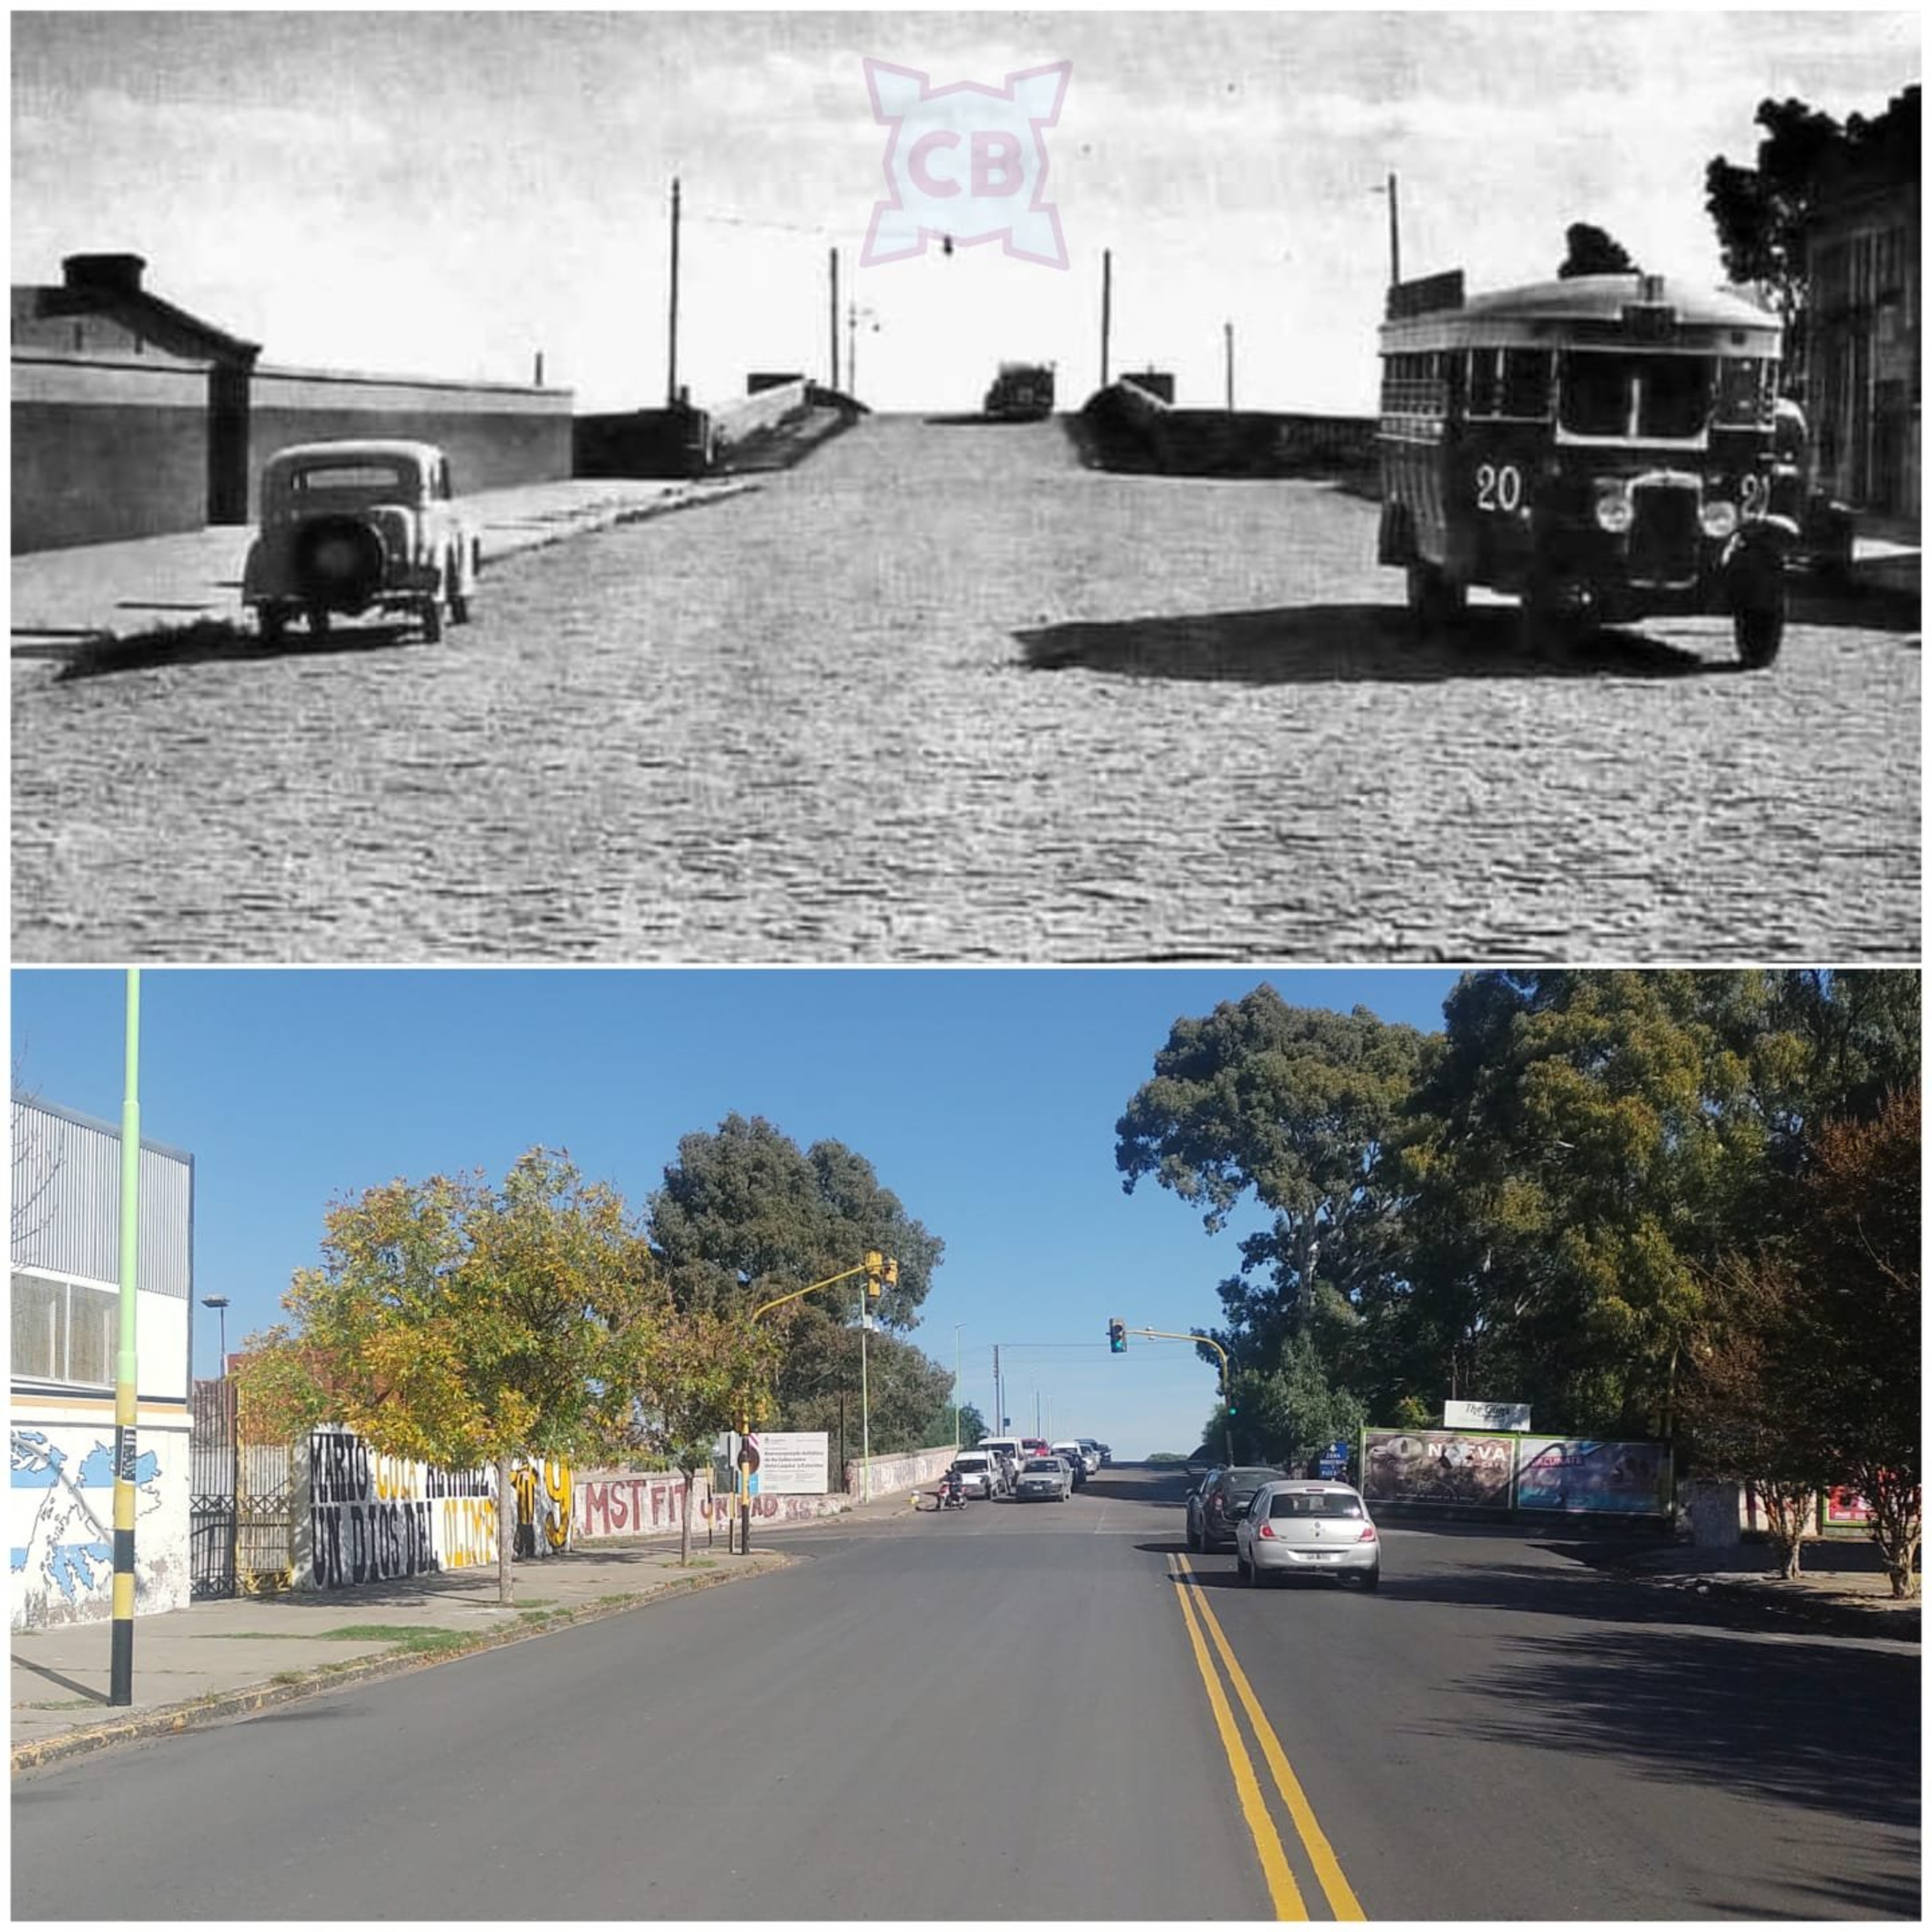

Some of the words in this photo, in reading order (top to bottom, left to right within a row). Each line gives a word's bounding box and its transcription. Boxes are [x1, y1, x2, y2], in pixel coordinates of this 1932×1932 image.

[1476, 463, 1520, 511] 20
[310, 1433, 368, 1503] MARIO
[1428, 1443, 1508, 1462] NEVA
[585, 1480, 647, 1535] MST
[310, 1506, 343, 1590] UN
[351, 1502, 399, 1584] DIOS
[404, 1501, 441, 1576] DEL
[444, 1498, 498, 1567] OLIMP
